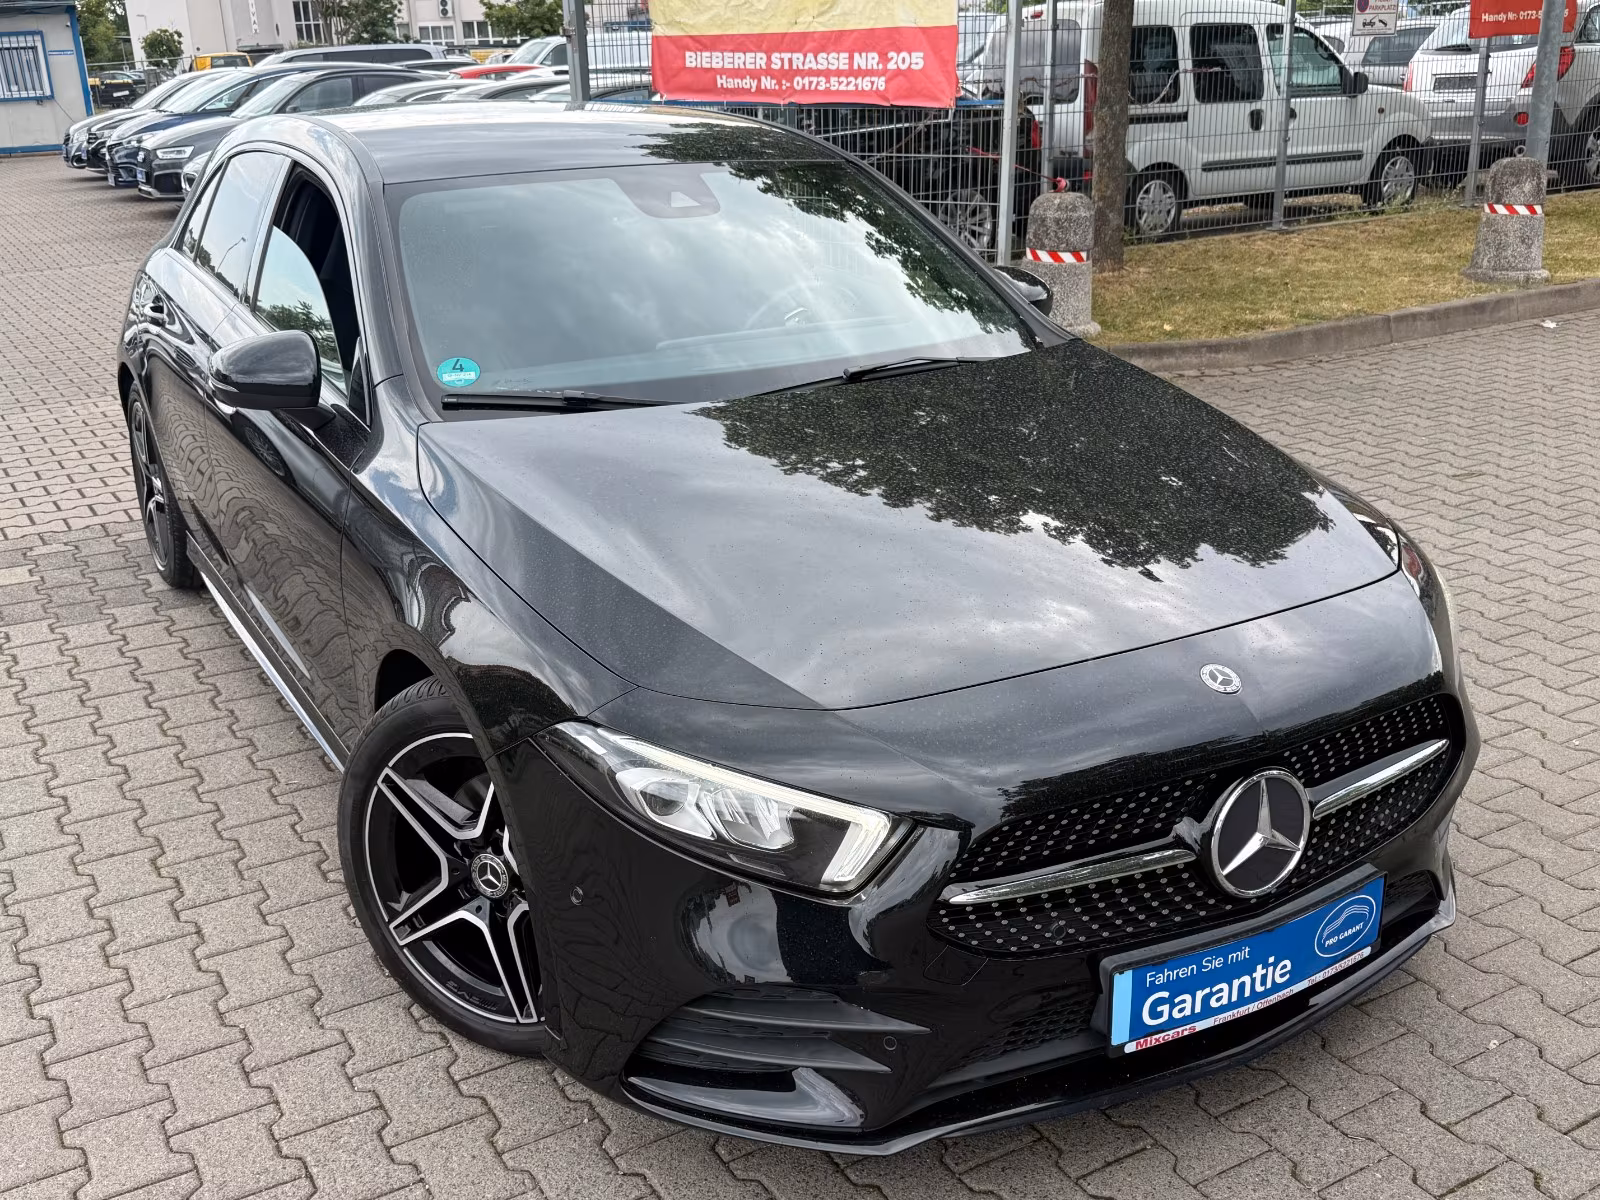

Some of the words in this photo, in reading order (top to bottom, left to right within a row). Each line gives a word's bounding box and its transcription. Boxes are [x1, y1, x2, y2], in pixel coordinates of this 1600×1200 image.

[1481, 13, 1506, 23] Handy
[1519, 9, 1569, 20] 0173-56
[685, 51, 767, 69] BIEBERER
[771, 52, 849, 70] STRASSE
[853, 52, 883, 70] NR.
[887, 51, 924, 70] 205
[716, 75, 758, 92] Handy
[761, 76, 779, 90] Nr.
[793, 76, 886, 91] 0173-5221676
[452, 358, 465, 372] 4
[1325, 936, 1338, 947] PRO
[1339, 922, 1364, 940] GARANT
[1146, 964, 1197, 988] Fahren
[1201, 955, 1224, 972] Sie
[1228, 946, 1250, 965] mit
[1142, 956, 1292, 1026] Garantie
[1135, 1025, 1197, 1051] Mixcars
[1213, 1007, 1250, 1025] Frankfurt
[1256, 988, 1294, 1010] Offenbach
